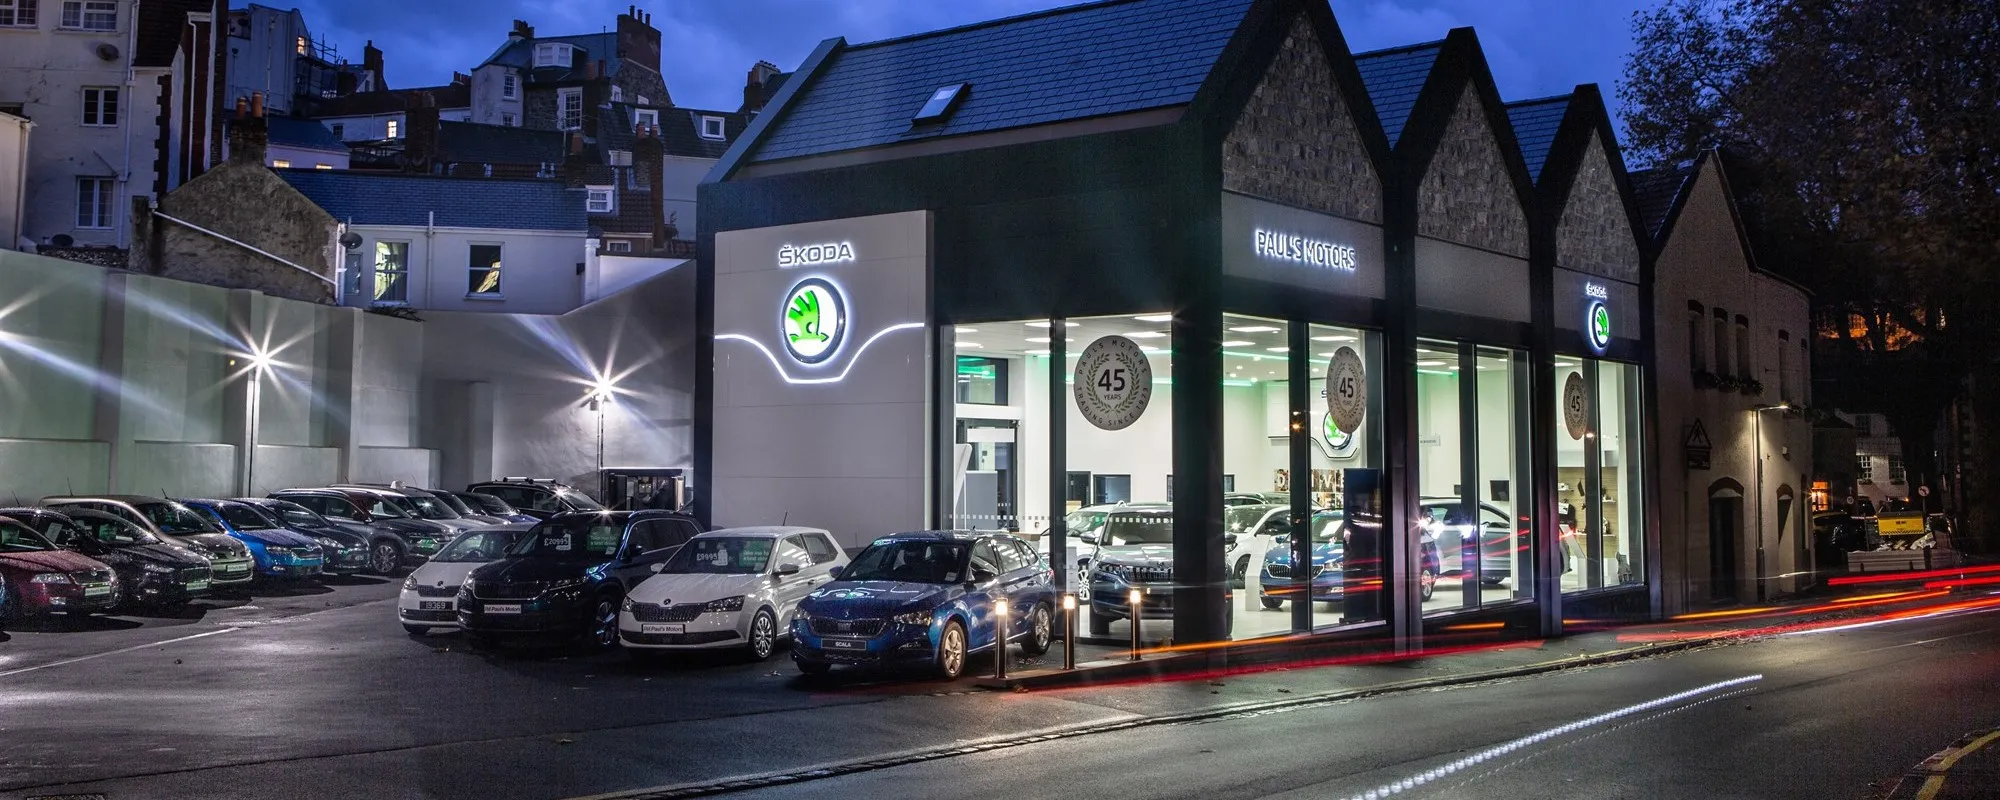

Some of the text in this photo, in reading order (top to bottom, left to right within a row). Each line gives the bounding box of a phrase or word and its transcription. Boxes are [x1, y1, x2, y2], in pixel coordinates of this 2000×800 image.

[778, 243, 853, 266] ŠKODA
[1256, 229, 1356, 269] PAUL'S MOTORS
[1078, 339, 1148, 375] PAULS MOTORS
[1097, 368, 1126, 392] 45
[1339, 377, 1354, 398] 45
[1076, 386, 1103, 424] TRADING
[1107, 412, 1135, 427] SINCE
[1103, 393, 1122, 401] YEARS
[1571, 395, 1581, 412] 45
